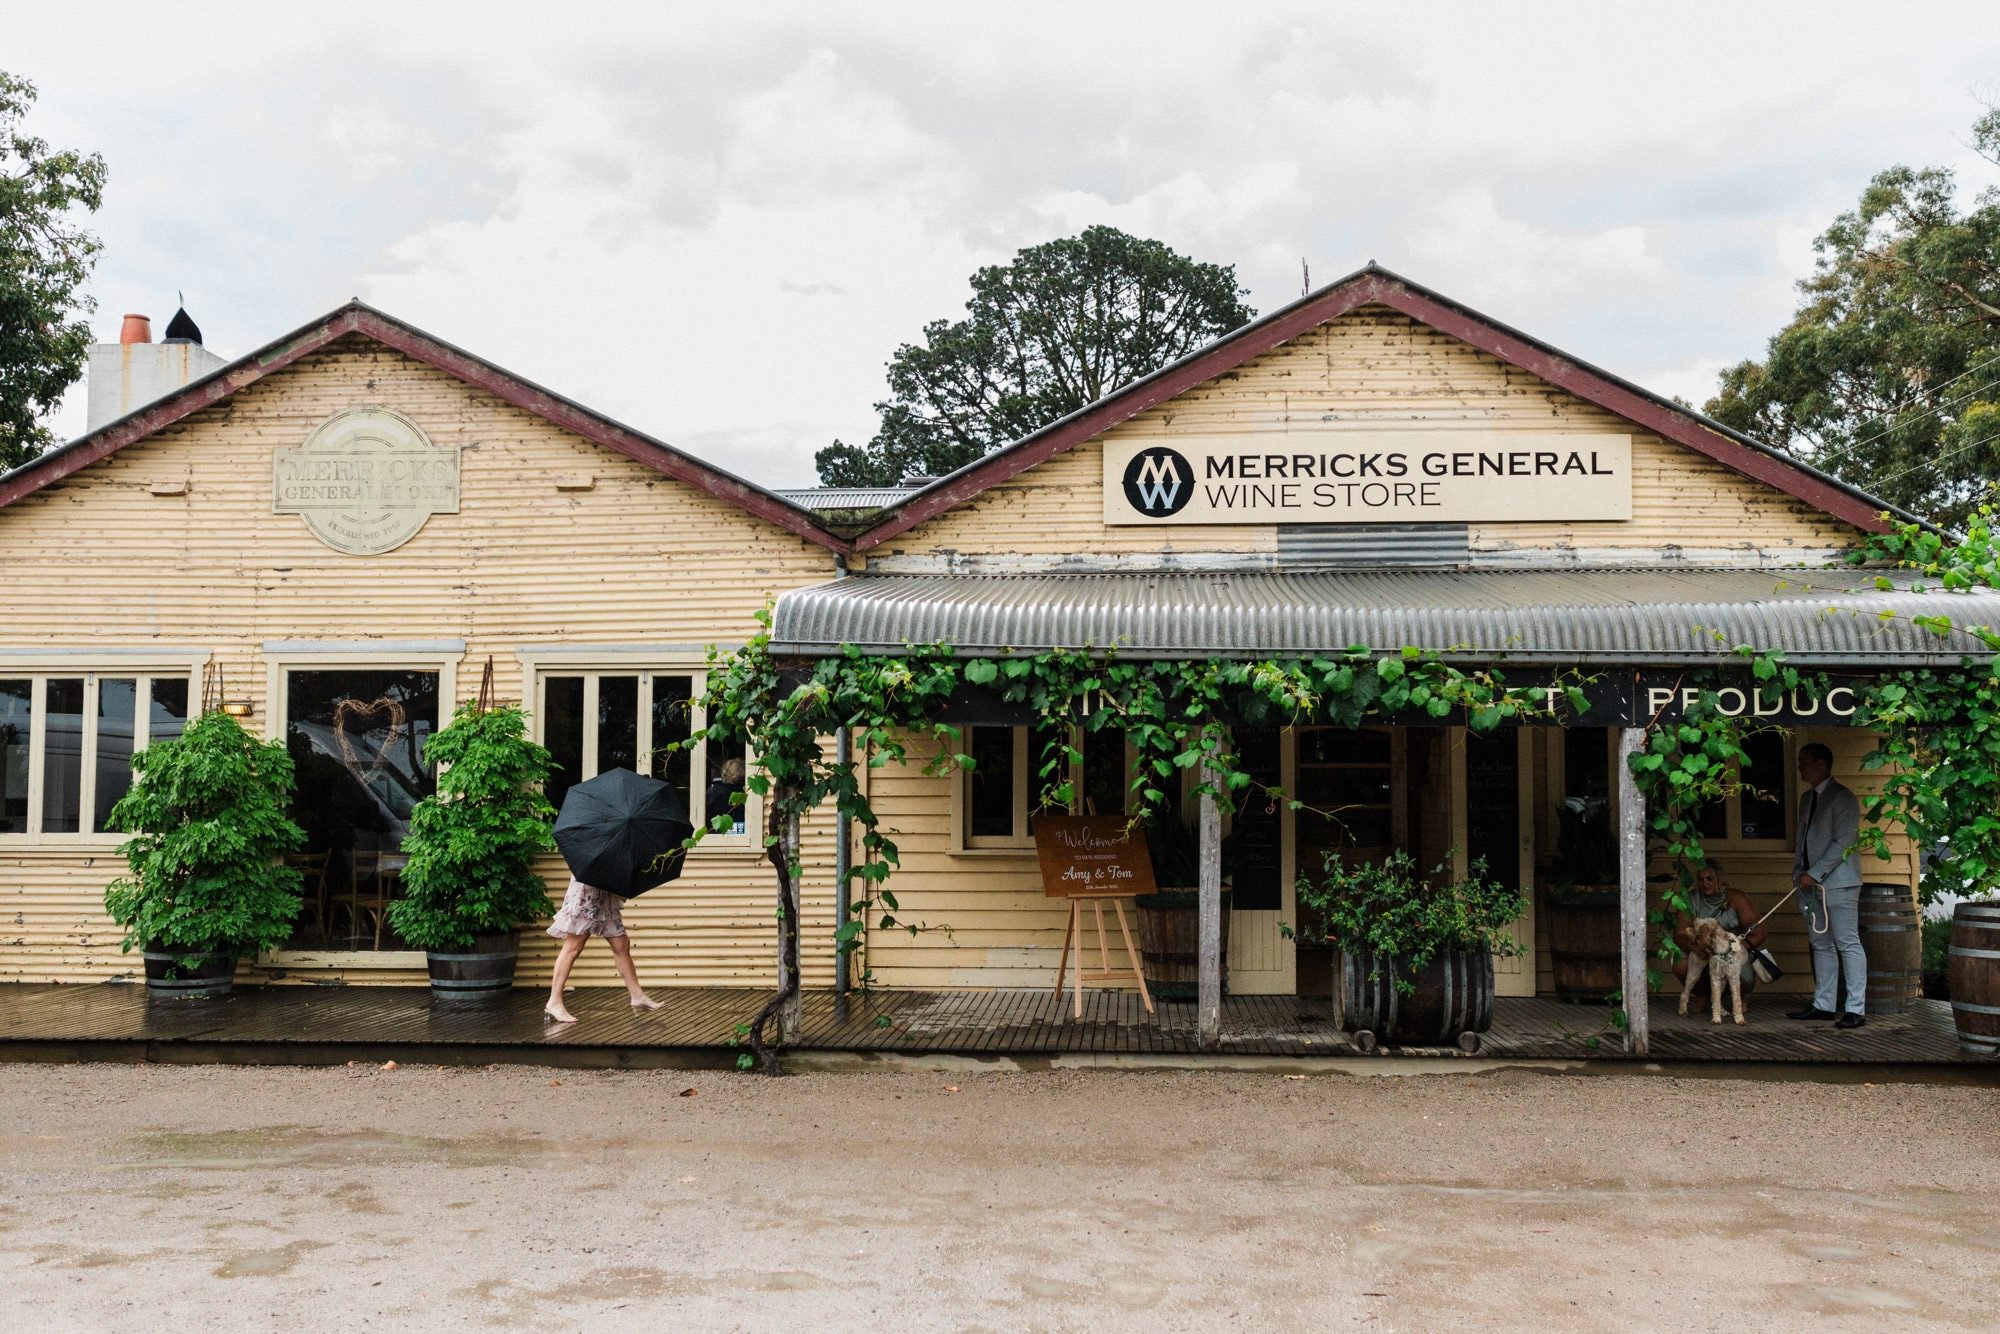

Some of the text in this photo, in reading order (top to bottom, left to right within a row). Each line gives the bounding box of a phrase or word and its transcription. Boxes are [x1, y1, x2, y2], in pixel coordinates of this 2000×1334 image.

[1206, 450, 1614, 479] MERRICKS GENERAL
[285, 485, 378, 500] GENERAL
[1205, 480, 1442, 509] WINE STORE
[1061, 864, 1133, 884] Amy & Tom
